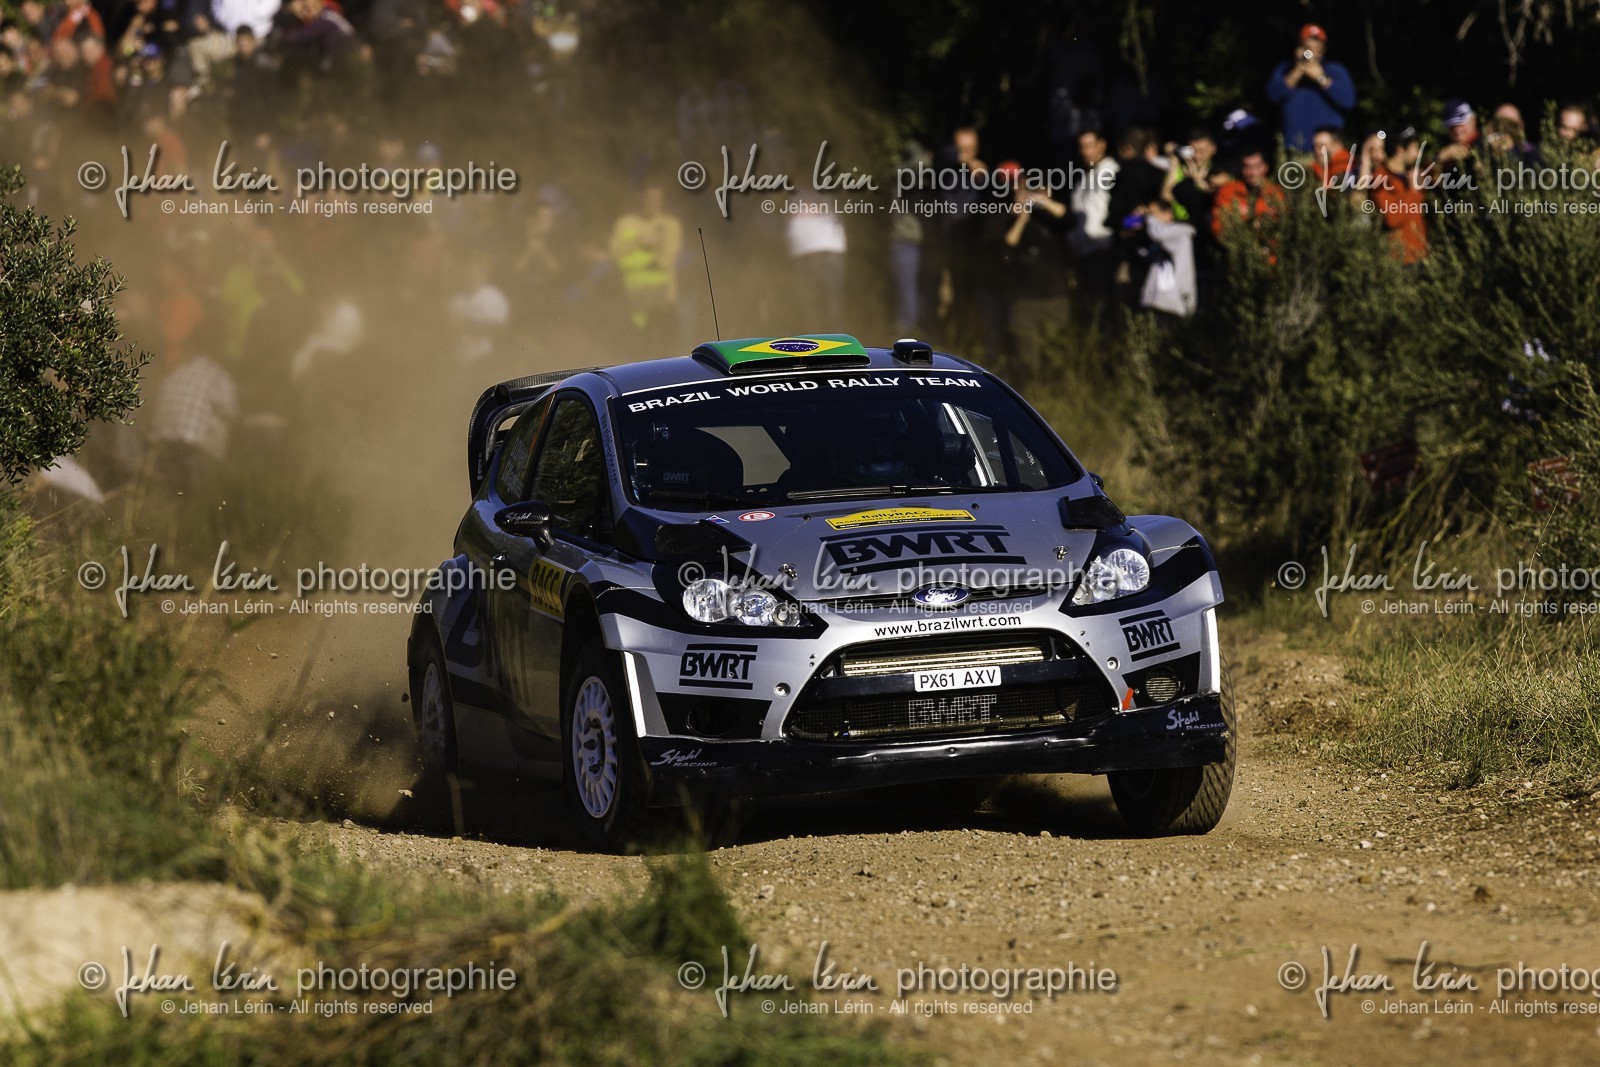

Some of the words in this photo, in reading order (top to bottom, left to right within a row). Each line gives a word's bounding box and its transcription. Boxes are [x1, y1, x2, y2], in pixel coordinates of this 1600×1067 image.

[627, 390, 720, 413] BRAZIL
[726, 380, 819, 397] WORLD
[827, 376, 900, 389] RALLY
[909, 376, 982, 388] TEAM
[861, 510, 931, 519] RallyRACC
[824, 530, 1011, 567] BWRT
[924, 586, 959, 602] Ford
[874, 614, 1022, 637] www.brazilwrt.com
[1121, 617, 1176, 653] BWRT
[679, 652, 757, 680] BWRT
[919, 673, 956, 690] PX61
[963, 669, 998, 686] AXV
[907, 693, 998, 730] BWRT
[1166, 708, 1200, 730] Stohl
[1185, 722, 1225, 730] RACING
[649, 747, 704, 766] Stohl
